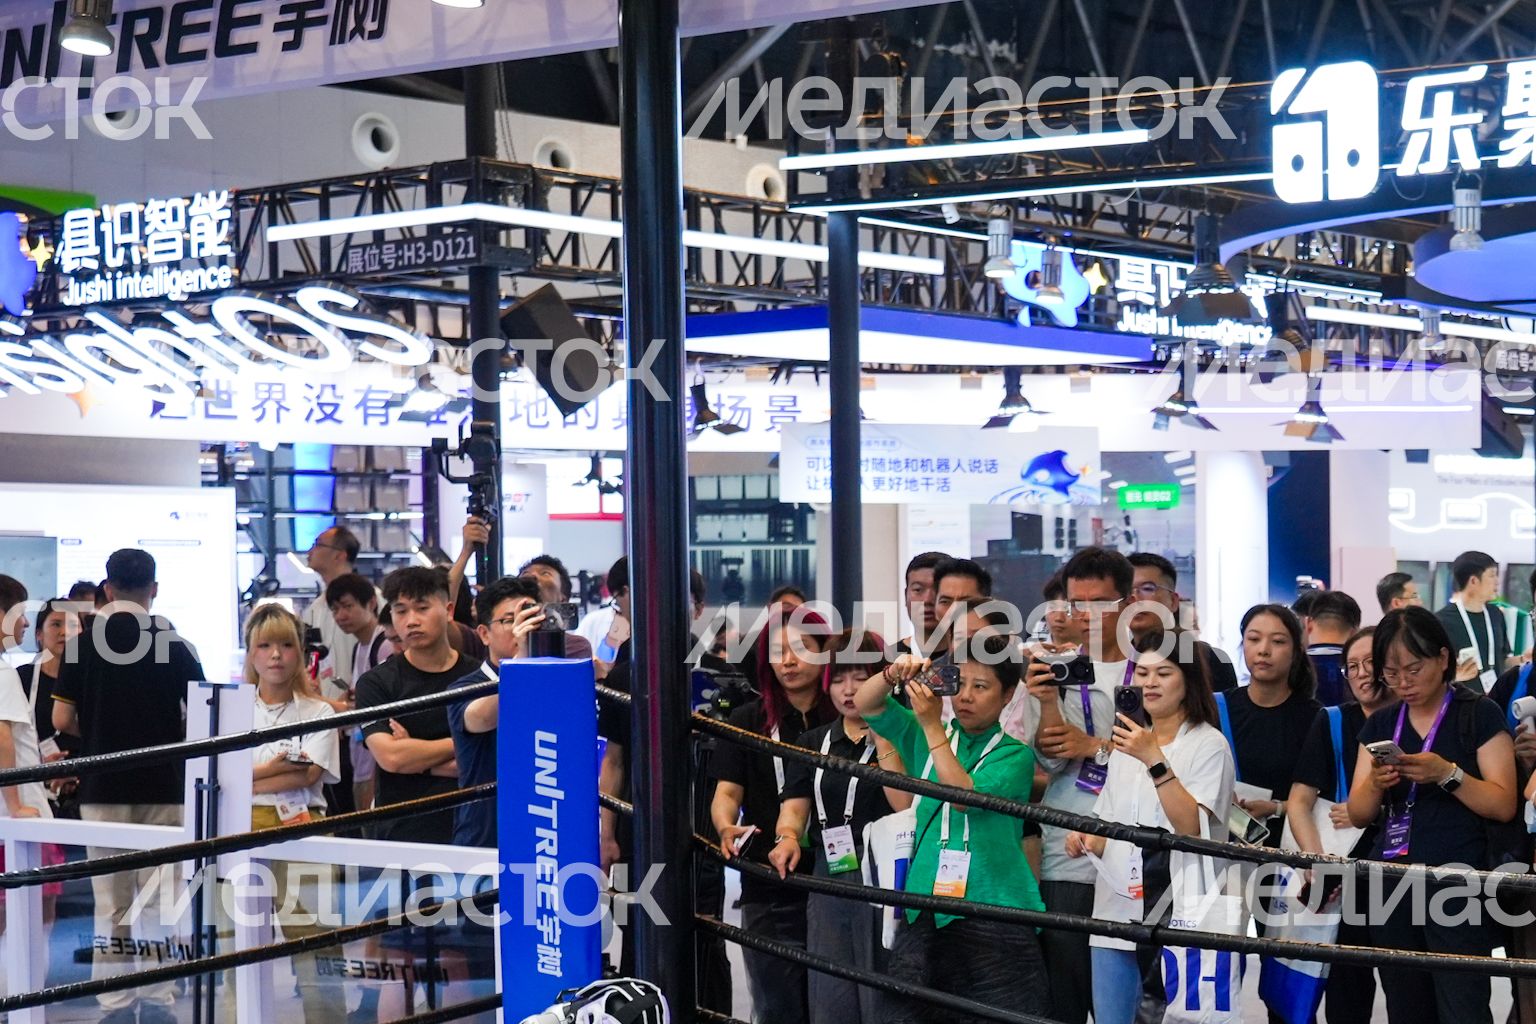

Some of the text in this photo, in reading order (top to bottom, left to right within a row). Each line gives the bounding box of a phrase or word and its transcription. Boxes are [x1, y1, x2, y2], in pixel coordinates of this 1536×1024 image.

[60, 190, 235, 271] 具识智能
[347, 235, 477, 274] 展位号:H3-D121
[63, 264, 232, 306] Jushi intelligence
[528, 729, 565, 978] UNITREE 宇树
